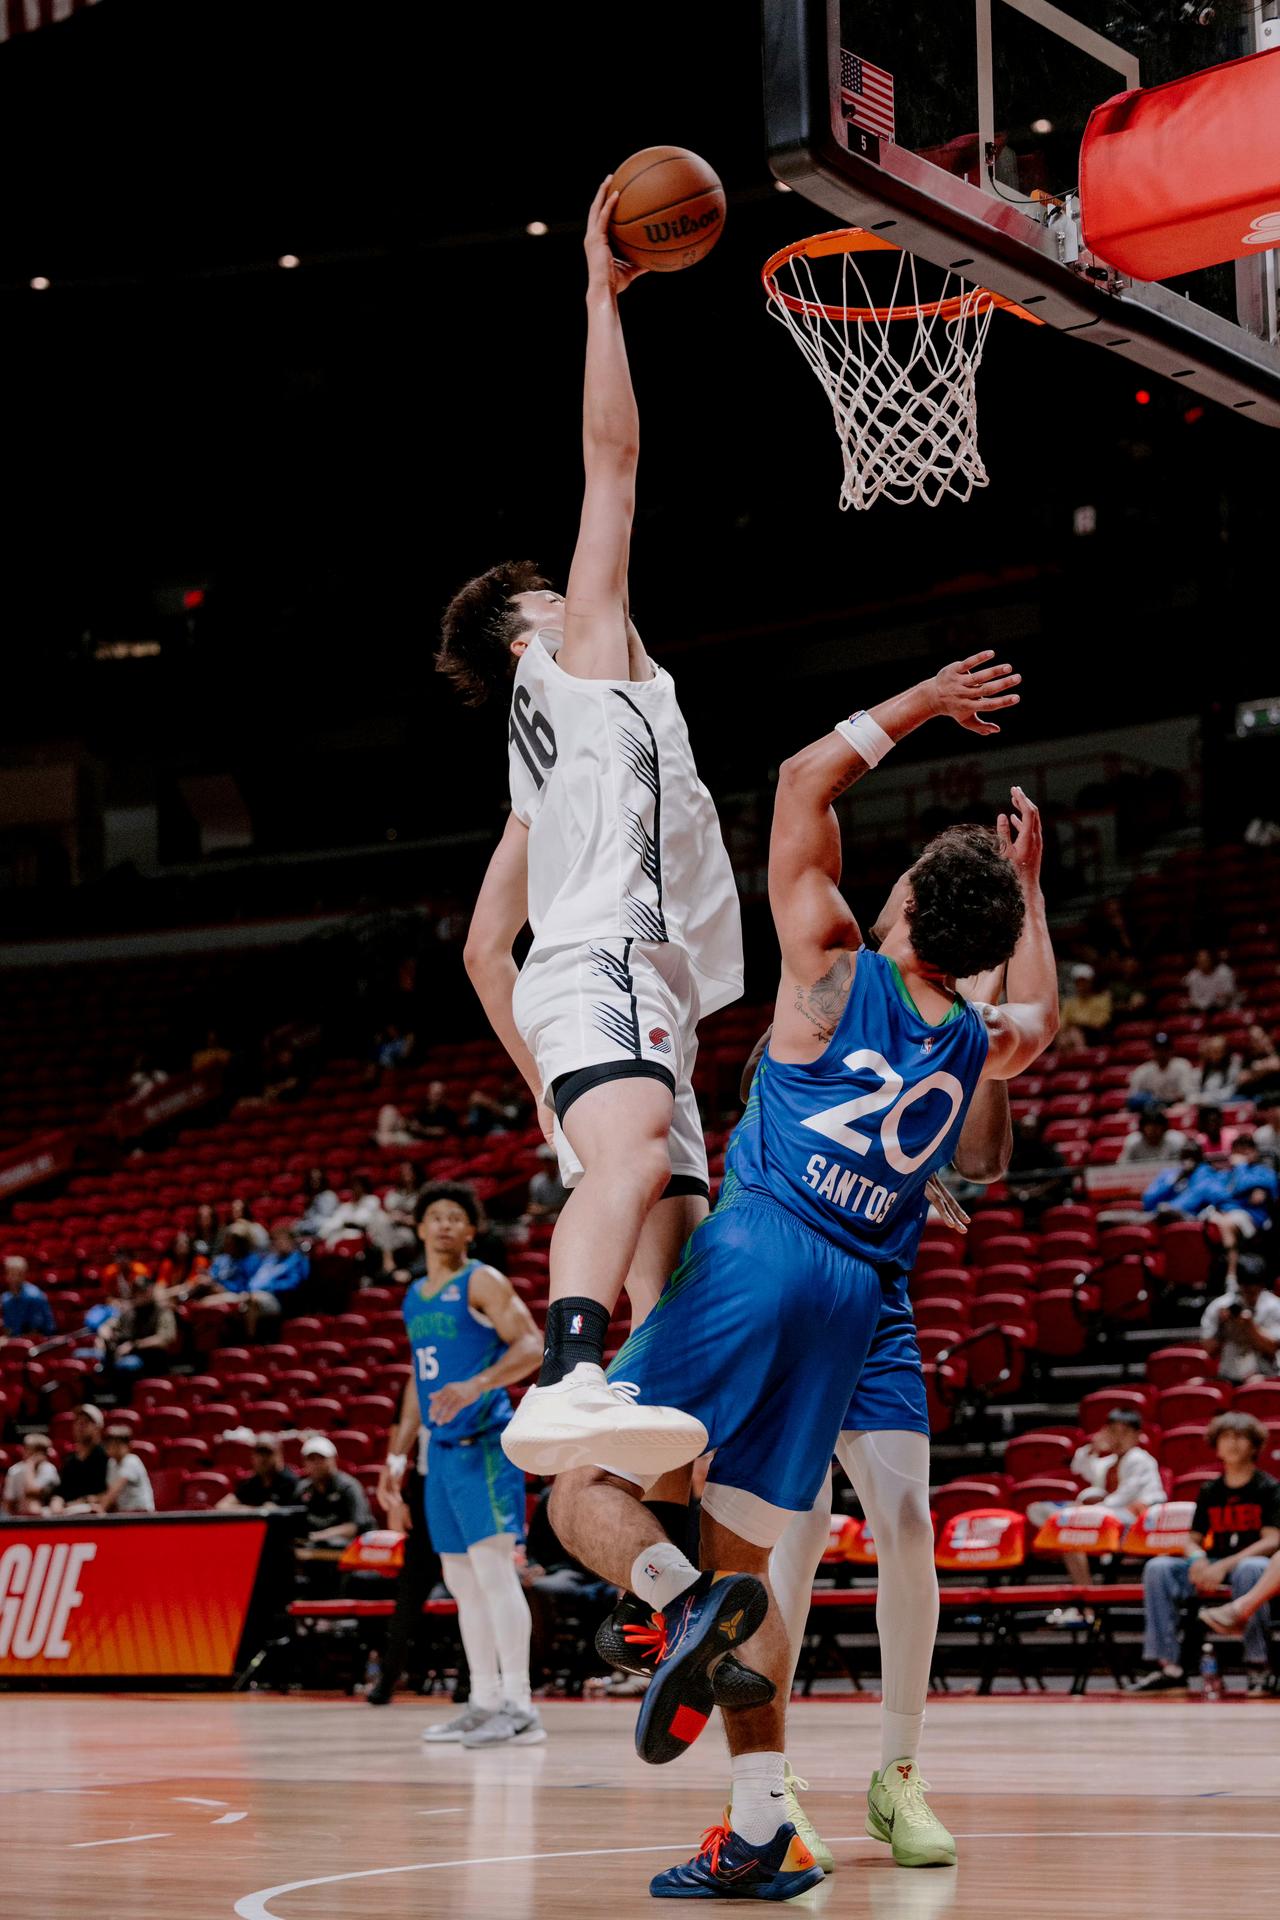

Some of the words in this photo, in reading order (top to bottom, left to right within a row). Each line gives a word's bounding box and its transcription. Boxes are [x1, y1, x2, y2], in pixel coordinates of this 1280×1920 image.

[861, 134, 867, 151] 5
[643, 207, 720, 243] Wilson
[510, 685, 558, 791] 16
[800, 1049, 963, 1175] 20
[801, 1153, 898, 1224] SANTOS
[415, 1345, 440, 1381] 15
